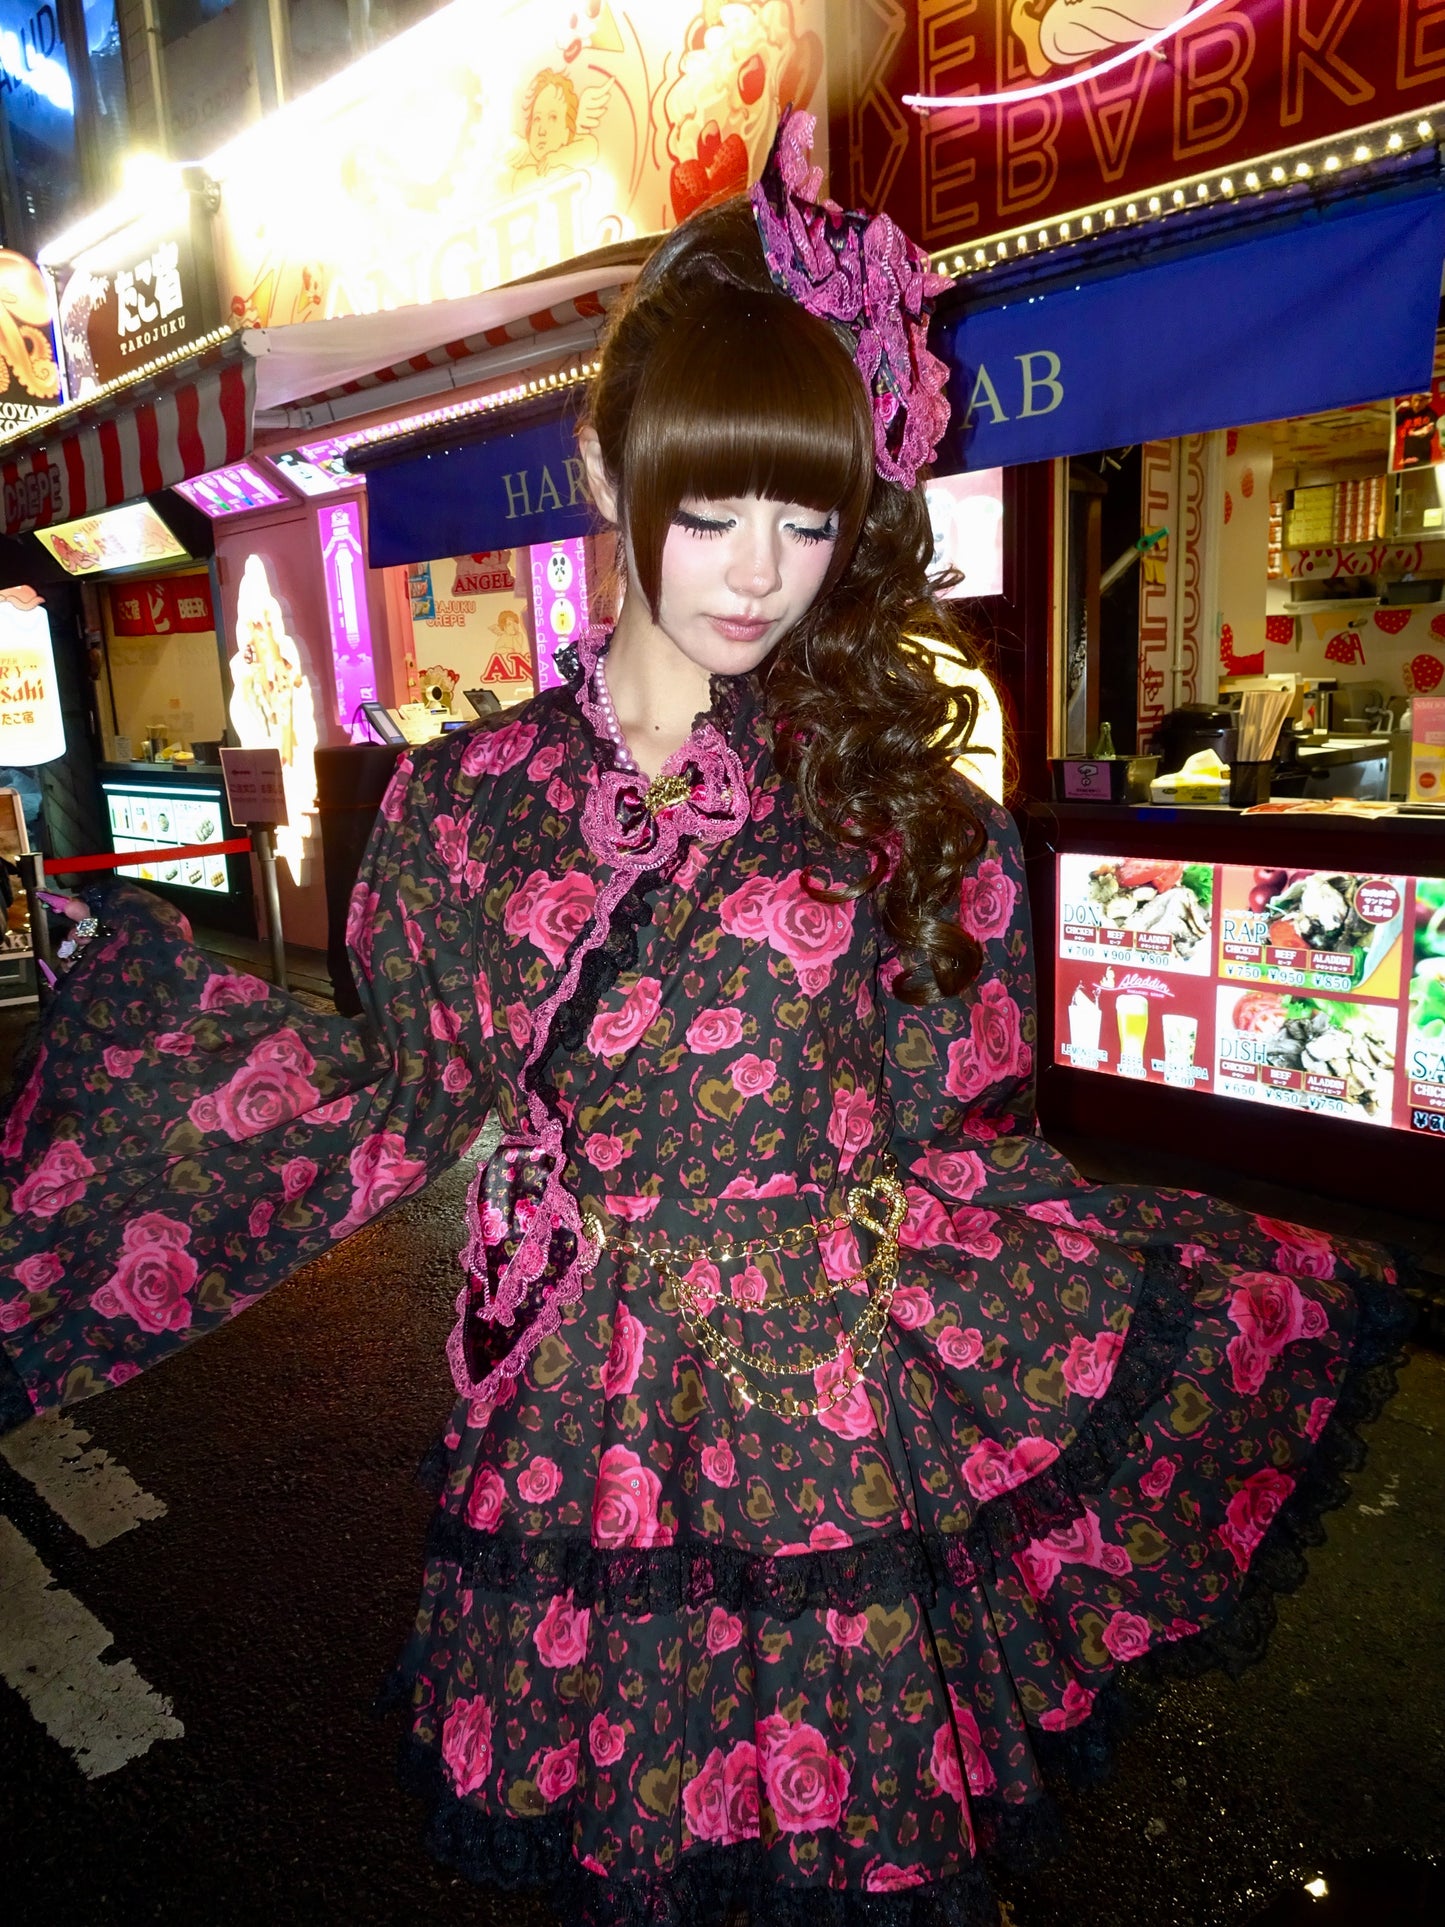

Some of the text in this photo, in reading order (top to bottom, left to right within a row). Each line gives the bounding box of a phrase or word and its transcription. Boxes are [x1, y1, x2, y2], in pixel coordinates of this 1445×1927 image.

[114, 241, 184, 337] たこ宿
[120, 315, 186, 356] TAKOJUKU
[454, 571, 515, 593] ANGEL
[531, 561, 546, 627] Crepes
[1, 711, 35, 726] たこ宿
[1065, 927, 1094, 937] CHICKEN
[1107, 930, 1125, 939] BEEF
[1223, 920, 1268, 943] RAP
[1138, 934, 1170, 945] ALADDIN
[1225, 944, 1260, 956] CHICKEN
[1275, 949, 1298, 960] BEEF
[1313, 954, 1351, 966] ALADDIN
[1117, 973, 1171, 993] Aladdin
[1220, 1037, 1267, 1064] DISH
[1270, 1069, 1292, 1080] BEEF
[1307, 1076, 1345, 1090] ALADDIN
